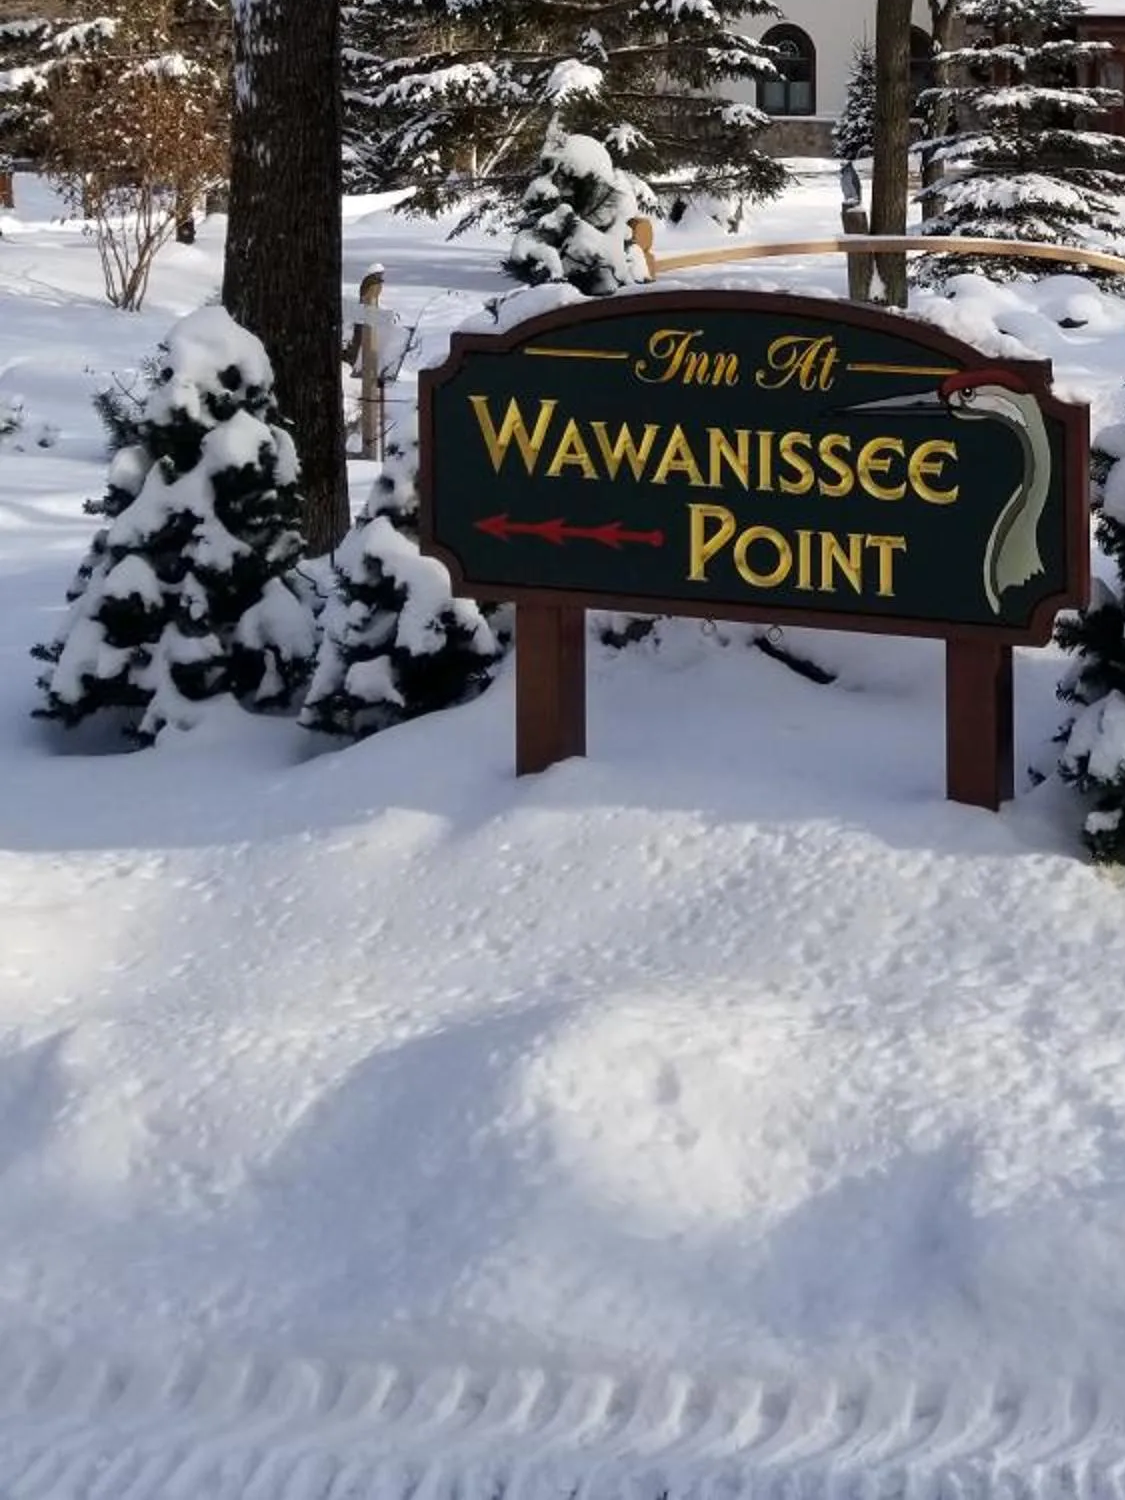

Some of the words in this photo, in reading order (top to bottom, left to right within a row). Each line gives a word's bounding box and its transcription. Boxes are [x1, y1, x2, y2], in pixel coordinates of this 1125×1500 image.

[634, 328, 740, 385] Inn
[755, 336, 838, 392] At
[467, 395, 960, 505] WAWANISSEE
[687, 502, 907, 597] POINT
